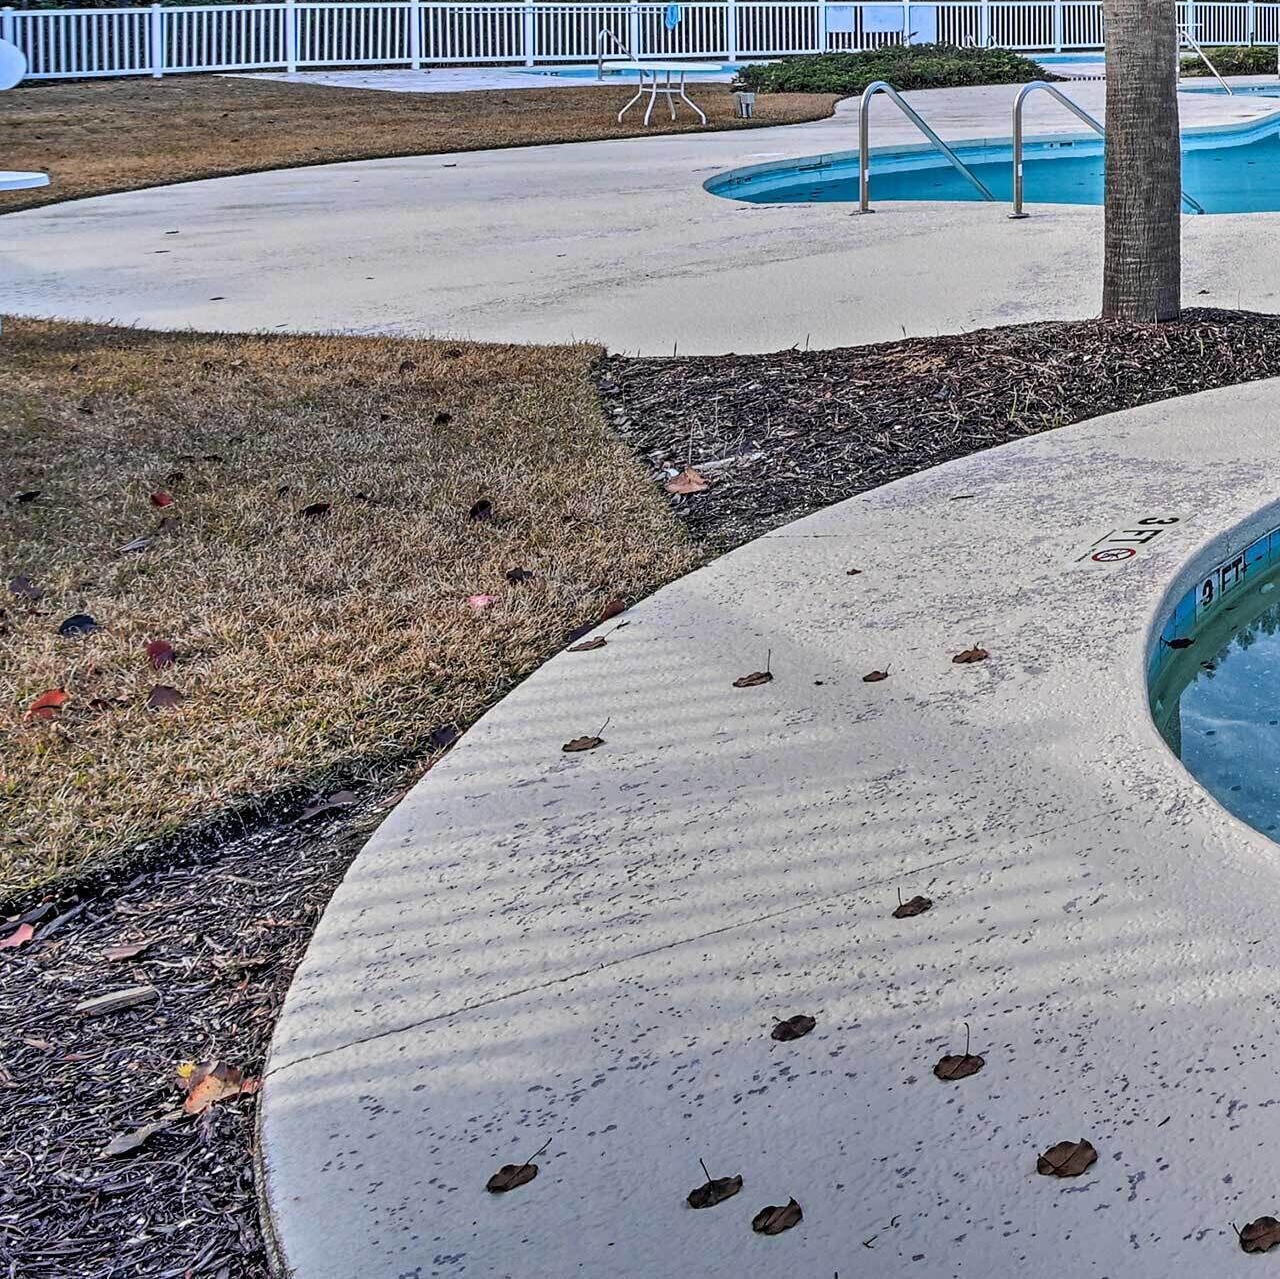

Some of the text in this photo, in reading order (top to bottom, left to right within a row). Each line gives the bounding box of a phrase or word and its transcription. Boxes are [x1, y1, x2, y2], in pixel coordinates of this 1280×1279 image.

[1108, 517, 1180, 544] 3 FT
[1221, 556, 1243, 592] FT
